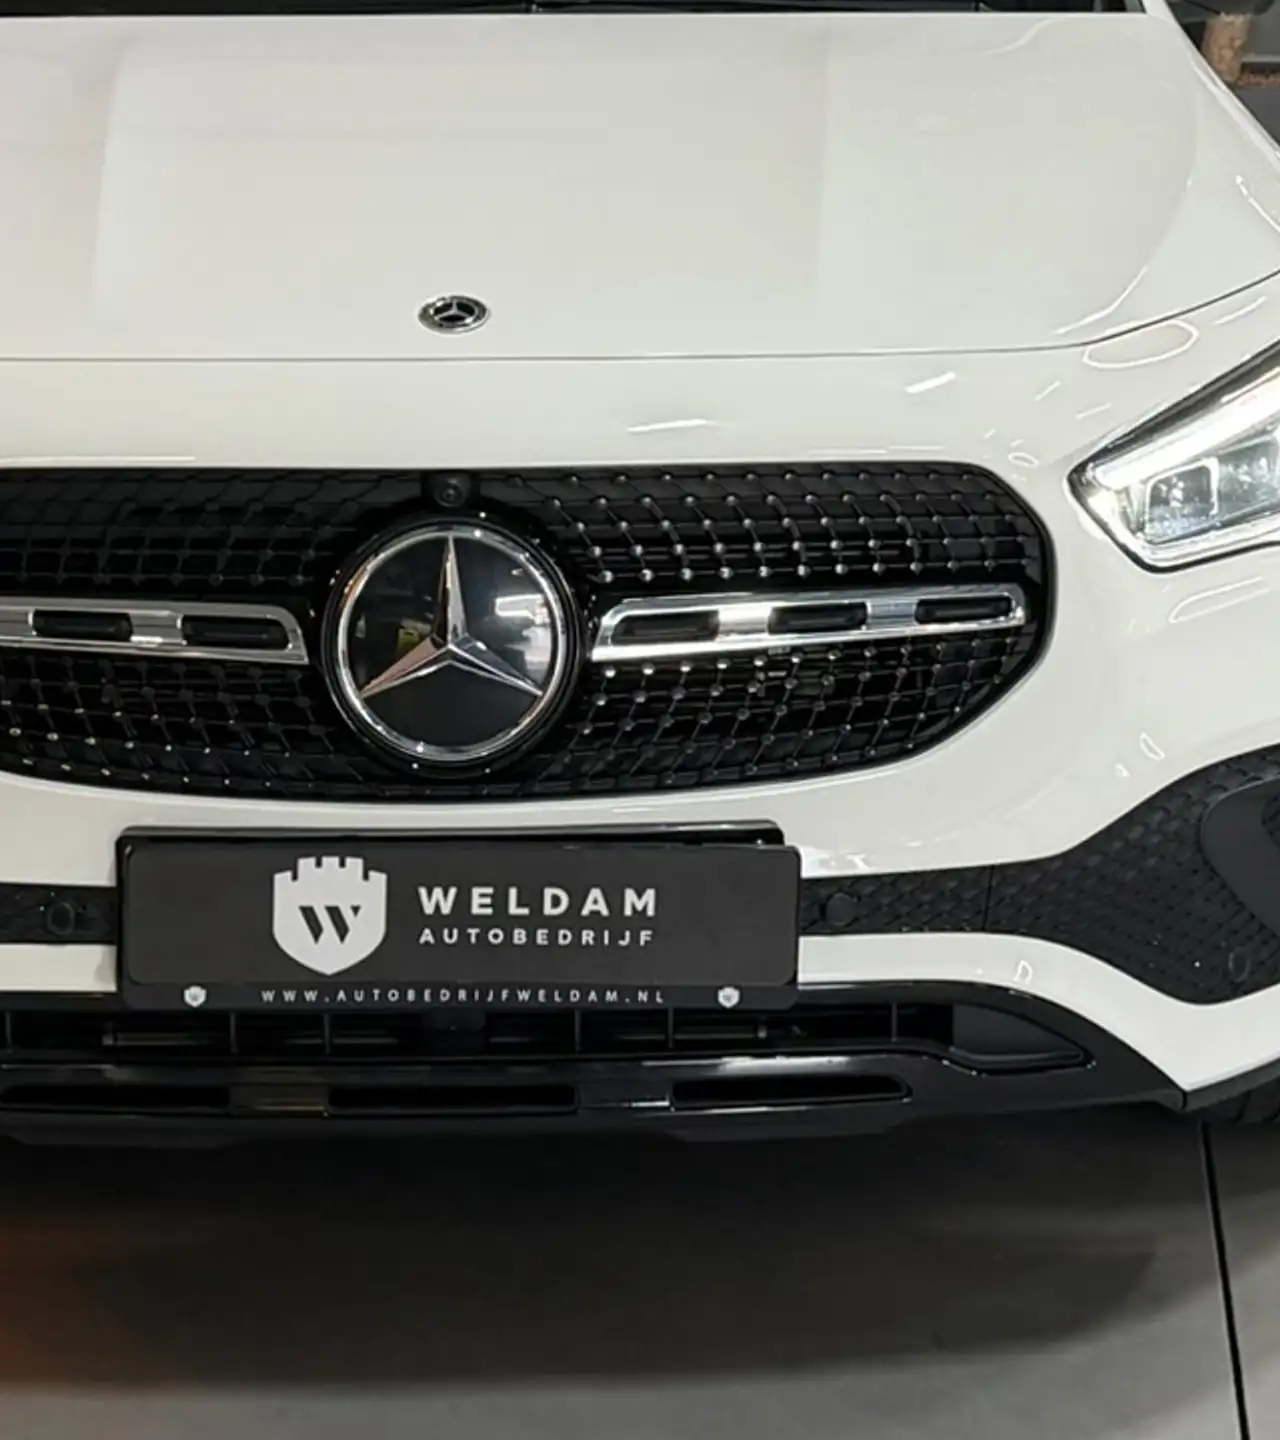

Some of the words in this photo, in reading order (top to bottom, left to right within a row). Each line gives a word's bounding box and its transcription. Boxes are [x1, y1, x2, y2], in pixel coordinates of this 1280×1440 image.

[418, 886, 656, 917] WELDAM
[419, 927, 654, 947] AUTOBEDRIJF
[261, 988, 664, 1004] WWW.AUTOBEDRIJFWELDAM.NL
